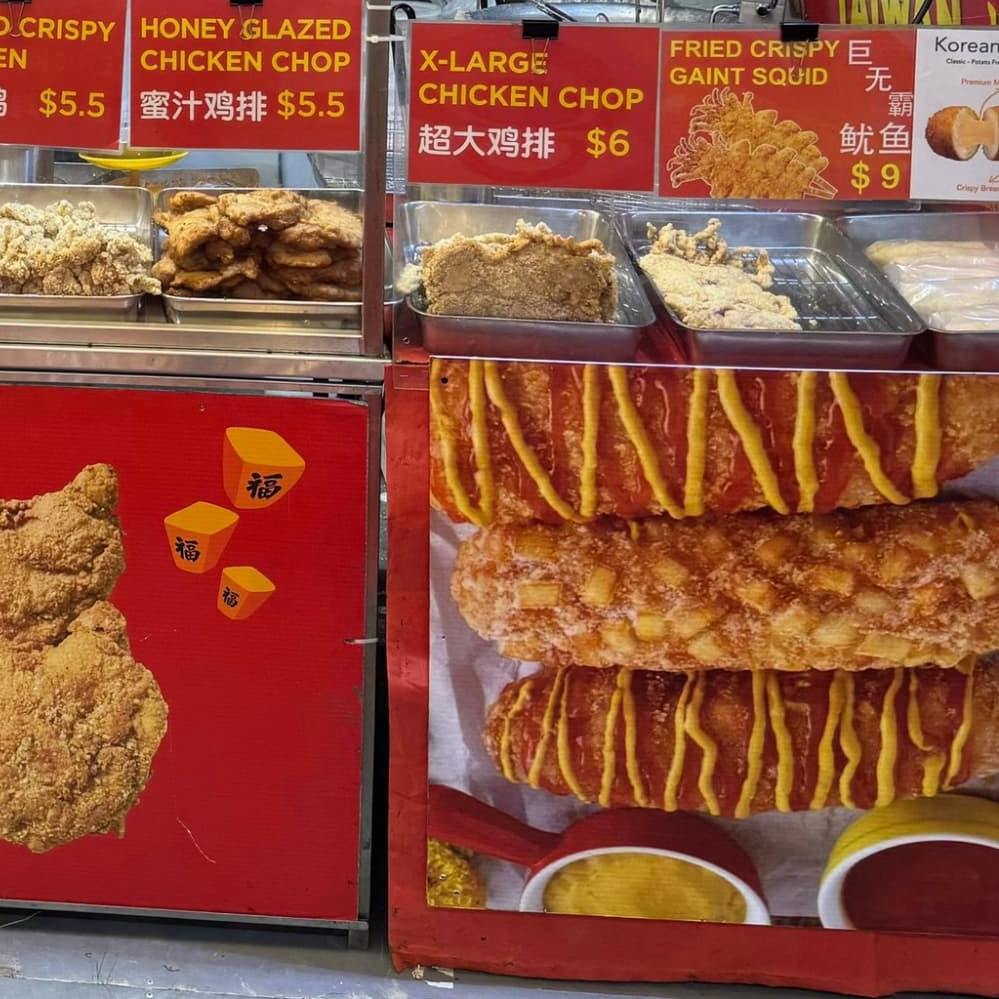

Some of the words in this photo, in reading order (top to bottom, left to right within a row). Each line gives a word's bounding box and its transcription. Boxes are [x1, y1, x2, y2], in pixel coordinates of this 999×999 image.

[18, 15, 117, 43] CRISPY
[140, 17, 235, 40] HONEY
[241, 17, 353, 41] GLAZED
[140, 49, 263, 73] CHICKEN
[271, 50, 352, 74] CHOP
[419, 49, 549, 75] X-LARGE
[669, 39, 743, 59] FRIED
[750, 39, 841, 59] CRISPY
[669, 67, 745, 86] GAINT
[752, 67, 829, 87] SQUID
[38, 87, 106, 119] $5.5
[139, 89, 268, 123] 蜜汁鸡排
[276, 88, 346, 119] $5.5
[418, 82, 549, 108] CHICKEN
[558, 86, 645, 111] CHOP
[418, 123, 556, 160] 超大鸡排
[586, 127, 631, 159] $6
[246, 472, 283, 500] 福
[174, 536, 201, 562] 福
[222, 586, 239, 608] 福
